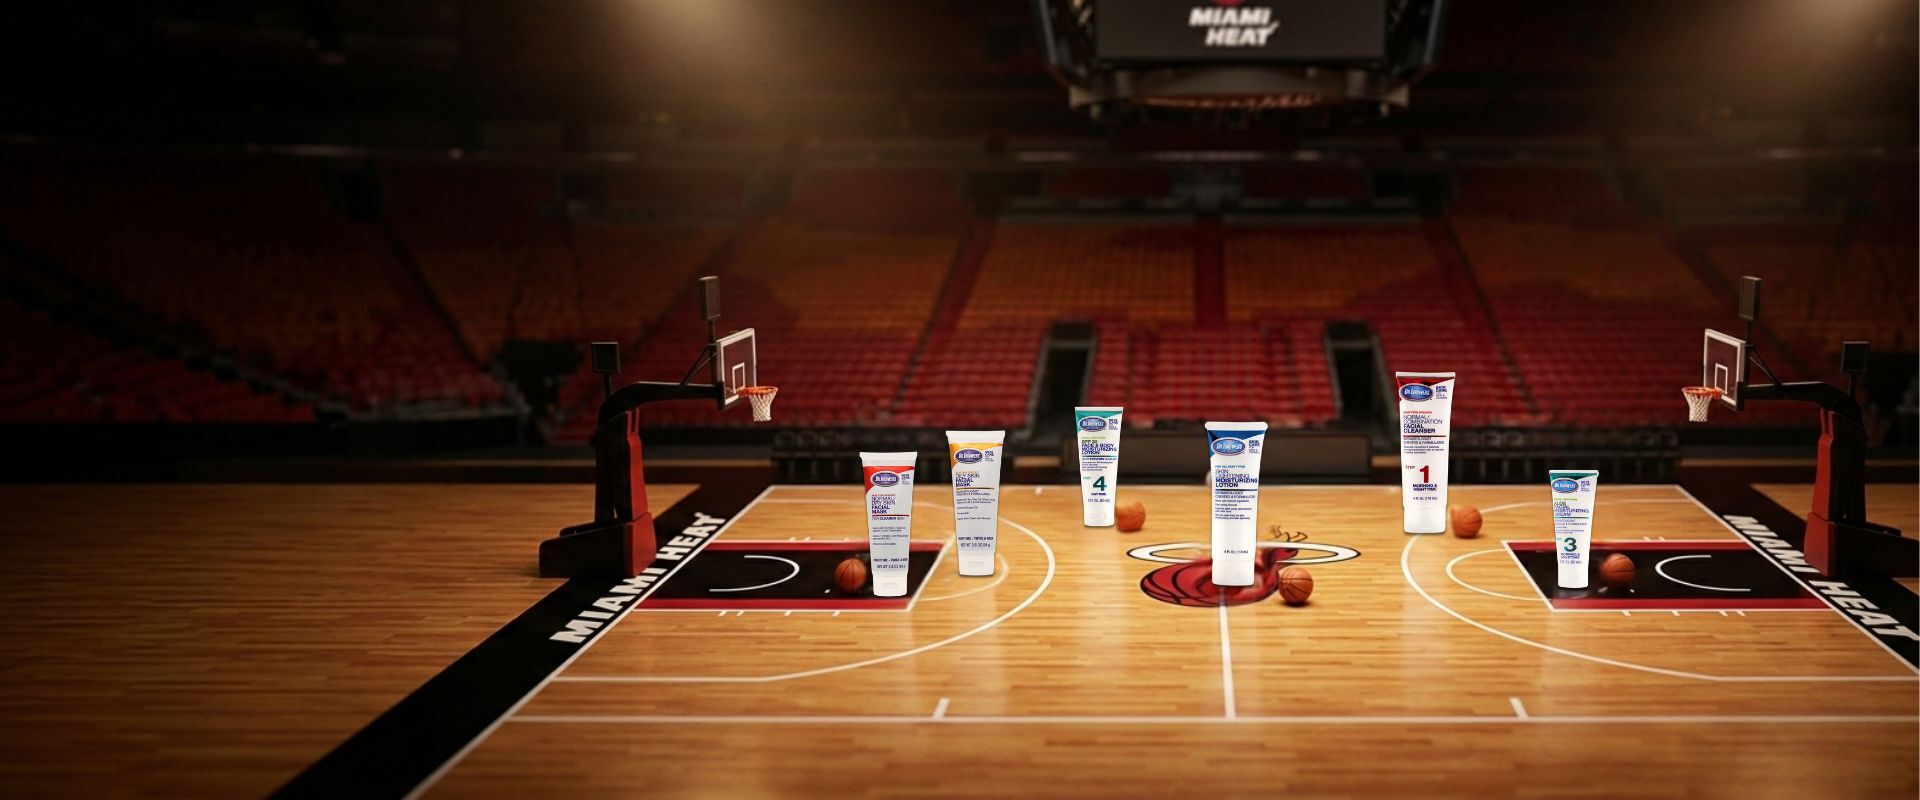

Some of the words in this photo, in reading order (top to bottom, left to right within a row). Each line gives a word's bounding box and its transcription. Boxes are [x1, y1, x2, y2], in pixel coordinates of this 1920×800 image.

[1189, 7, 1271, 26] MIAMI
[1205, 20, 1279, 46] HEAT
[1092, 475, 1108, 492] 4
[1419, 465, 1429, 484] 1
[1563, 537, 1577, 552] 3
[549, 567, 668, 644] MIAMI
[655, 511, 727, 561] HEAT
[1722, 514, 1820, 574] MIAMI
[1808, 579, 1920, 642] HEAT
